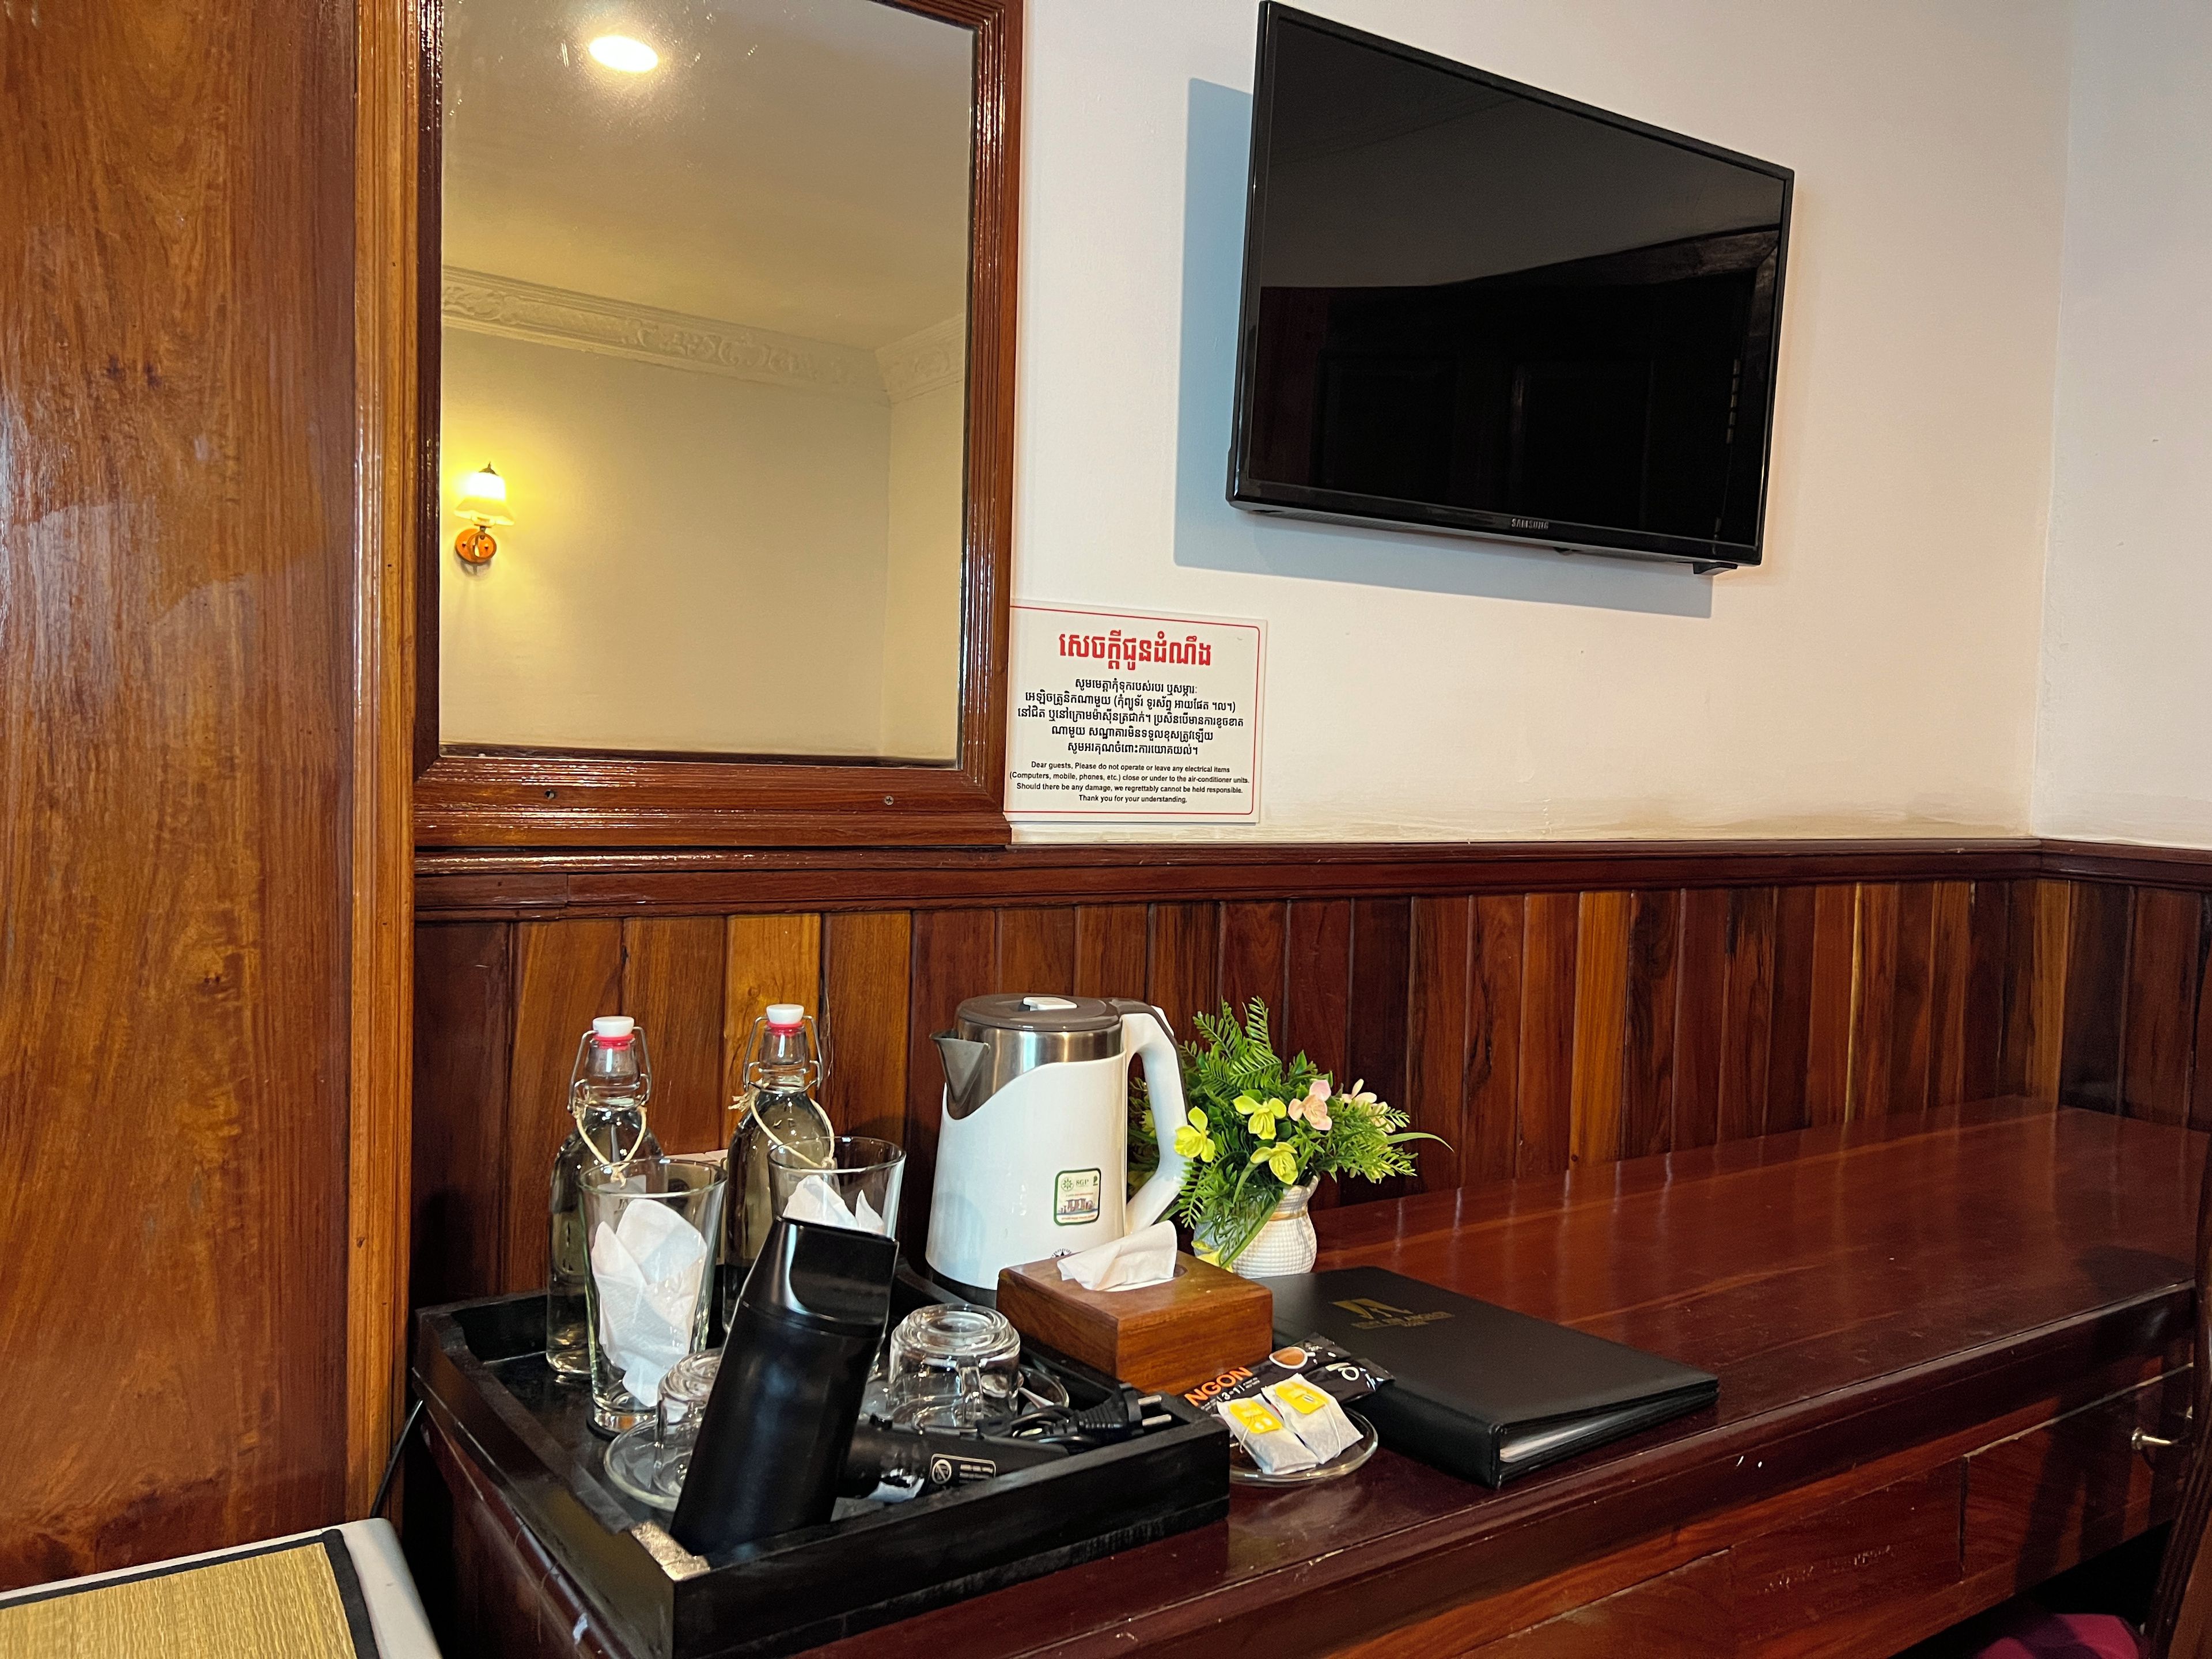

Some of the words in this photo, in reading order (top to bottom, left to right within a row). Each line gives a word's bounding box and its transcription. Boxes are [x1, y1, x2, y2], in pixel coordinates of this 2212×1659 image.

[1512, 518, 1548, 530] SAMSUNG
[1124, 785, 1159, 793] regrettably
[1184, 1366, 1254, 1407] NGON
